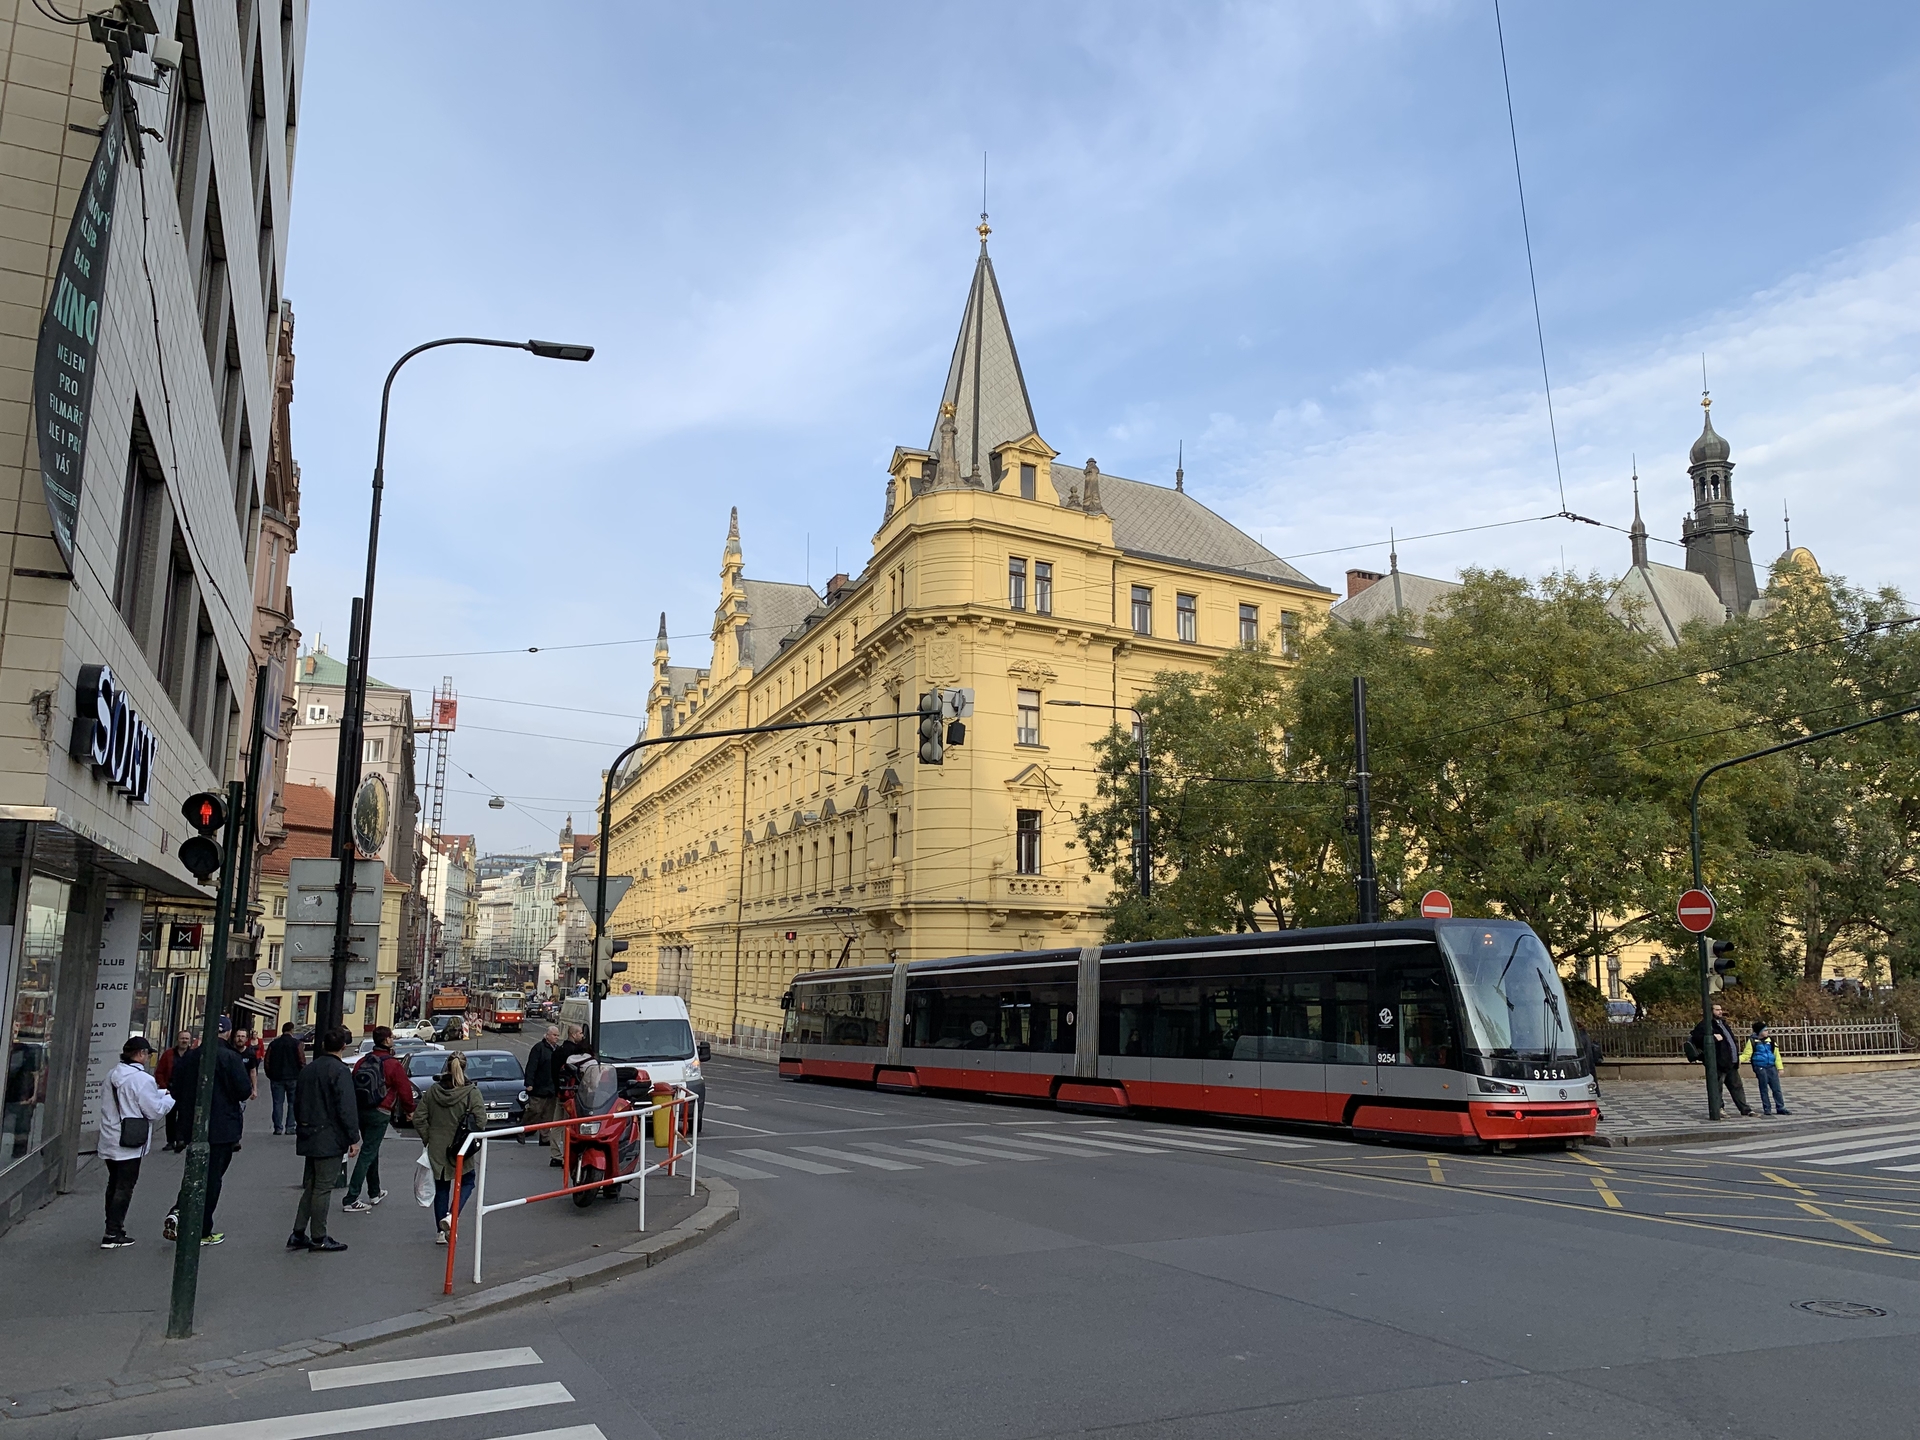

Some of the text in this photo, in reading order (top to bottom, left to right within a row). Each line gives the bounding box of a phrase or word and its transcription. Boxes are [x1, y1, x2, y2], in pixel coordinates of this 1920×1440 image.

[73, 246, 91, 279] BAR
[53, 271, 98, 347] KINO
[57, 342, 86, 373] NEJEN
[59, 372, 79, 396] PRO
[61, 429, 65, 445] I
[55, 452, 70, 475] VÁS
[90, 664, 159, 806] SONY
[1377, 1053, 1396, 1063] 9254
[1533, 1069, 1566, 1080] 9254
